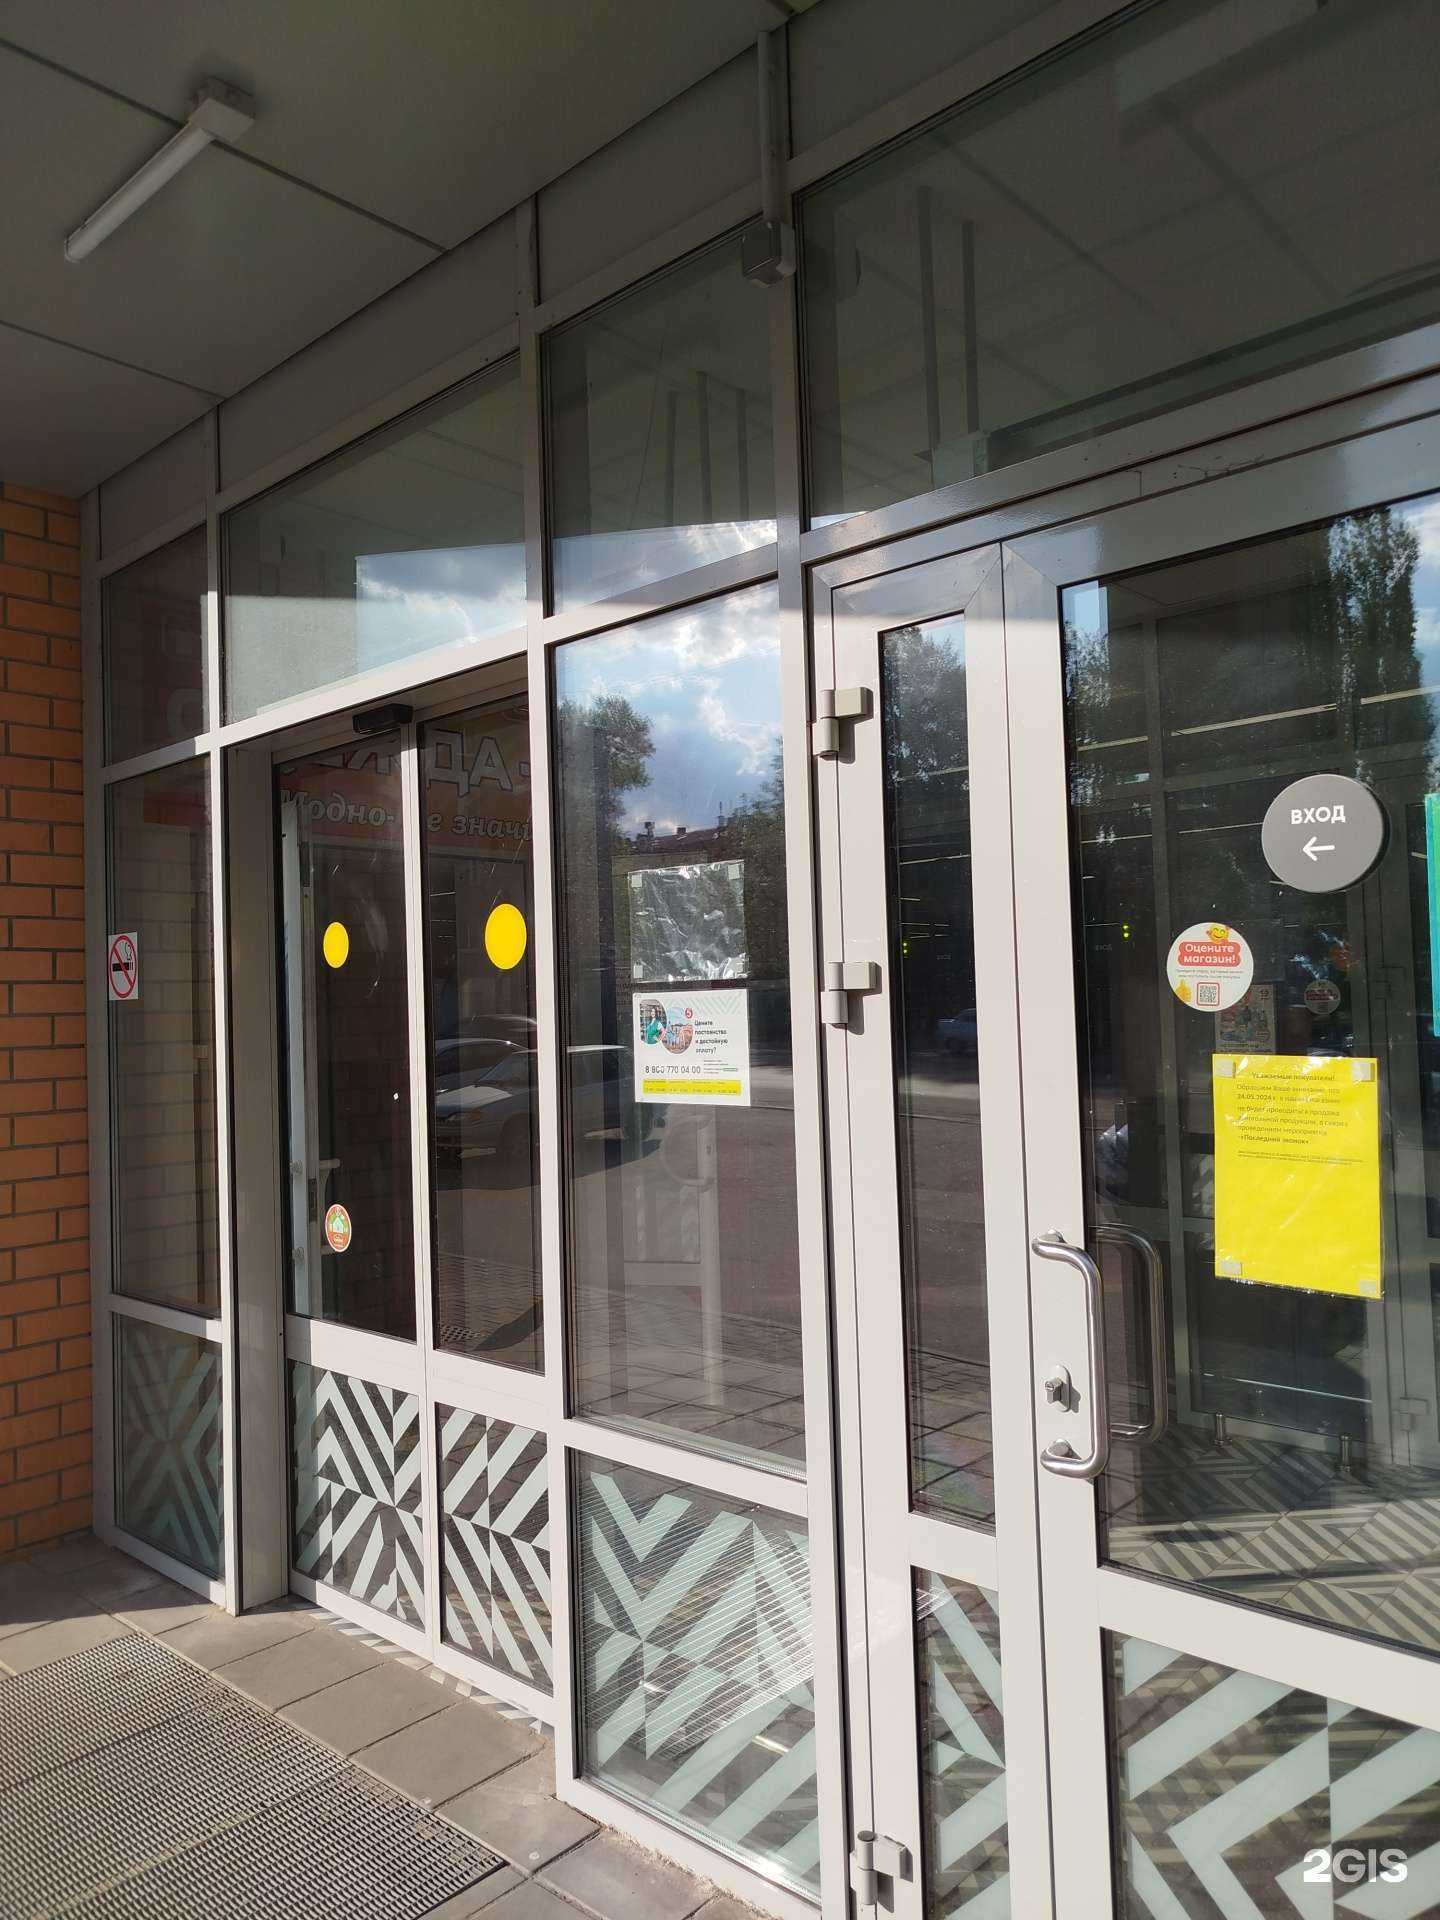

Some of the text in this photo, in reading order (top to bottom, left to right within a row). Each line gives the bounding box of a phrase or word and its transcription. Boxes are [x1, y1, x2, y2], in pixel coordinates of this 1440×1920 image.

[1290, 804, 1347, 825] ВХОД
[1184, 943, 1235, 954] Оцените
[1183, 955, 1236, 964] магазин!
[645, 1065, 650, 1074] 8
[666, 1065, 679, 1074] 770
[680, 1065, 690, 1074] 04
[691, 1066, 701, 1074] 00
